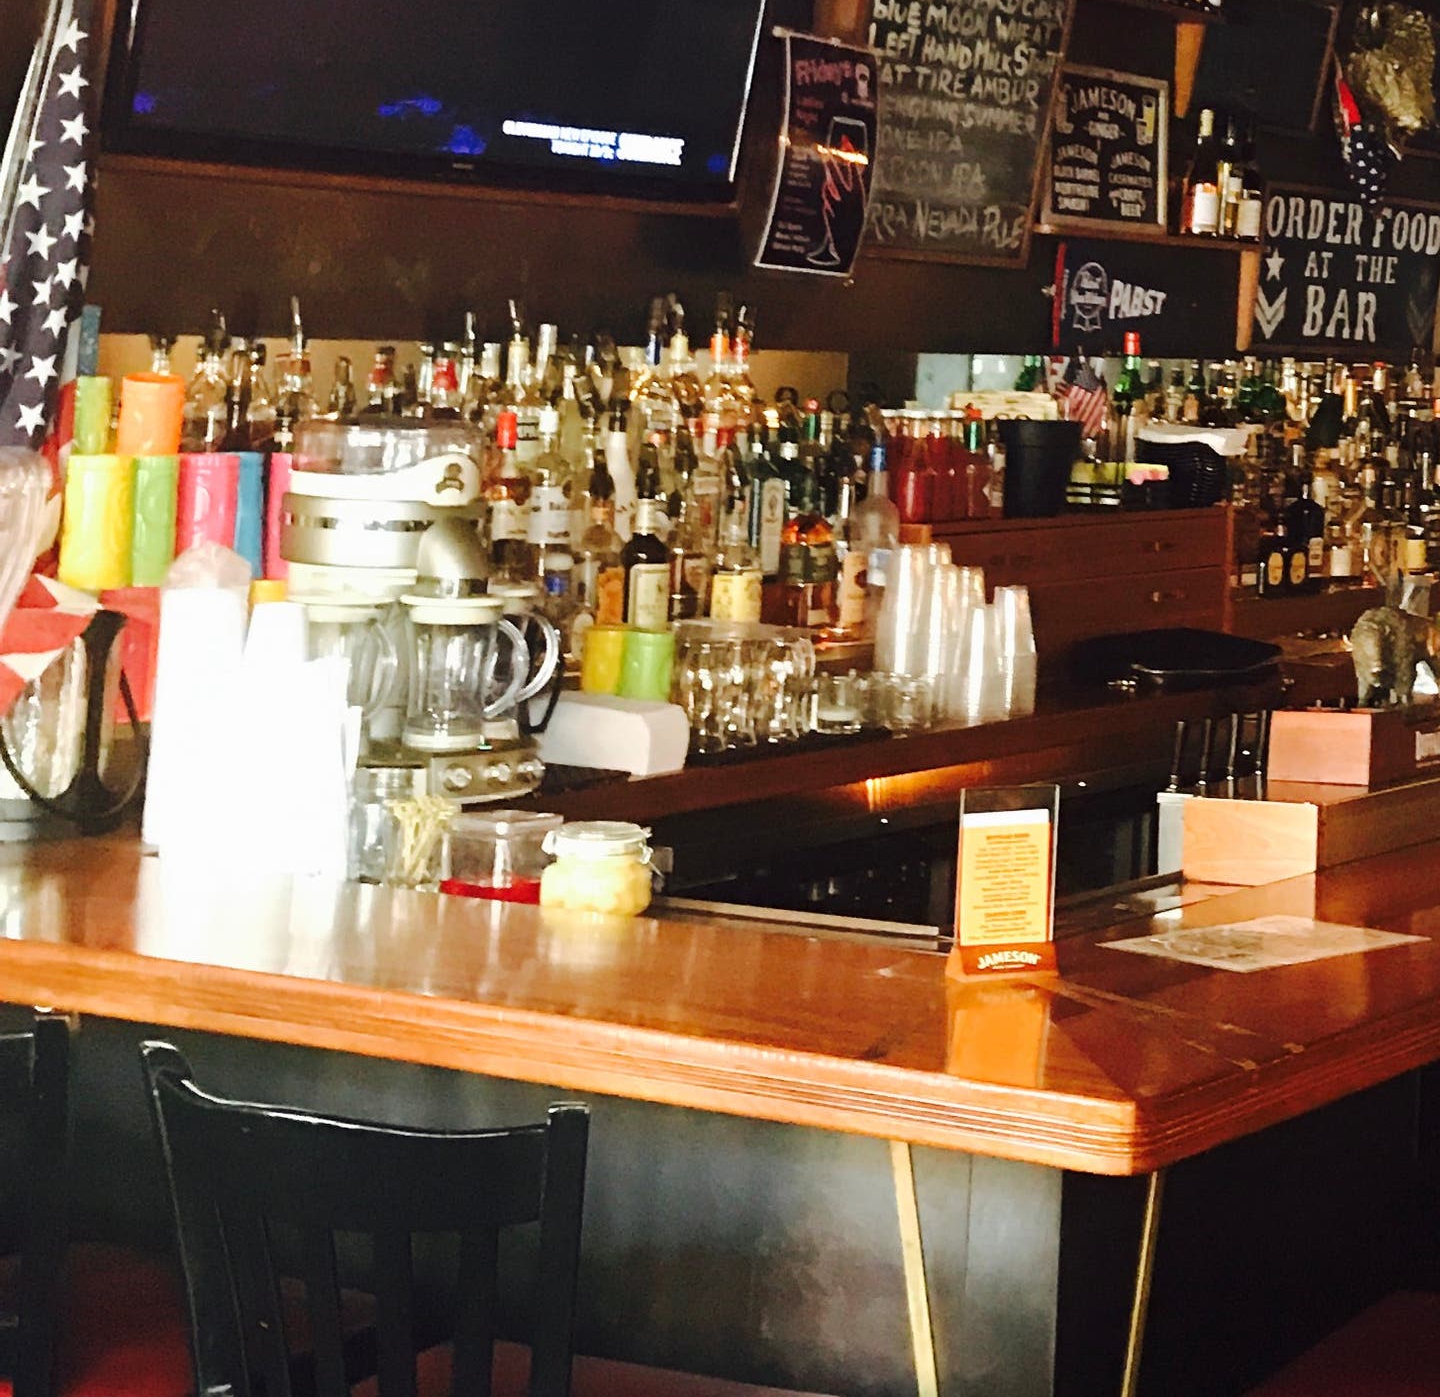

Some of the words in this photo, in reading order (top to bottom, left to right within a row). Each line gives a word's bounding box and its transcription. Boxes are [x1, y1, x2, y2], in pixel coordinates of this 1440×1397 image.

[926, 2, 989, 38] MOON
[868, 22, 921, 59] LEFT
[922, 32, 973, 71] HAND
[879, 65, 911, 88] AT
[914, 65, 967, 98] TIRE
[1070, 85, 1137, 122] JAMESON
[880, 124, 922, 151] ONE
[1266, 194, 1363, 245] ORDER
[1304, 250, 1333, 280] AT
[1355, 253, 1400, 285] THE
[1108, 279, 1167, 320] PABST
[1302, 284, 1377, 343] BAR
[977, 949, 1040, 970] JAMESON
